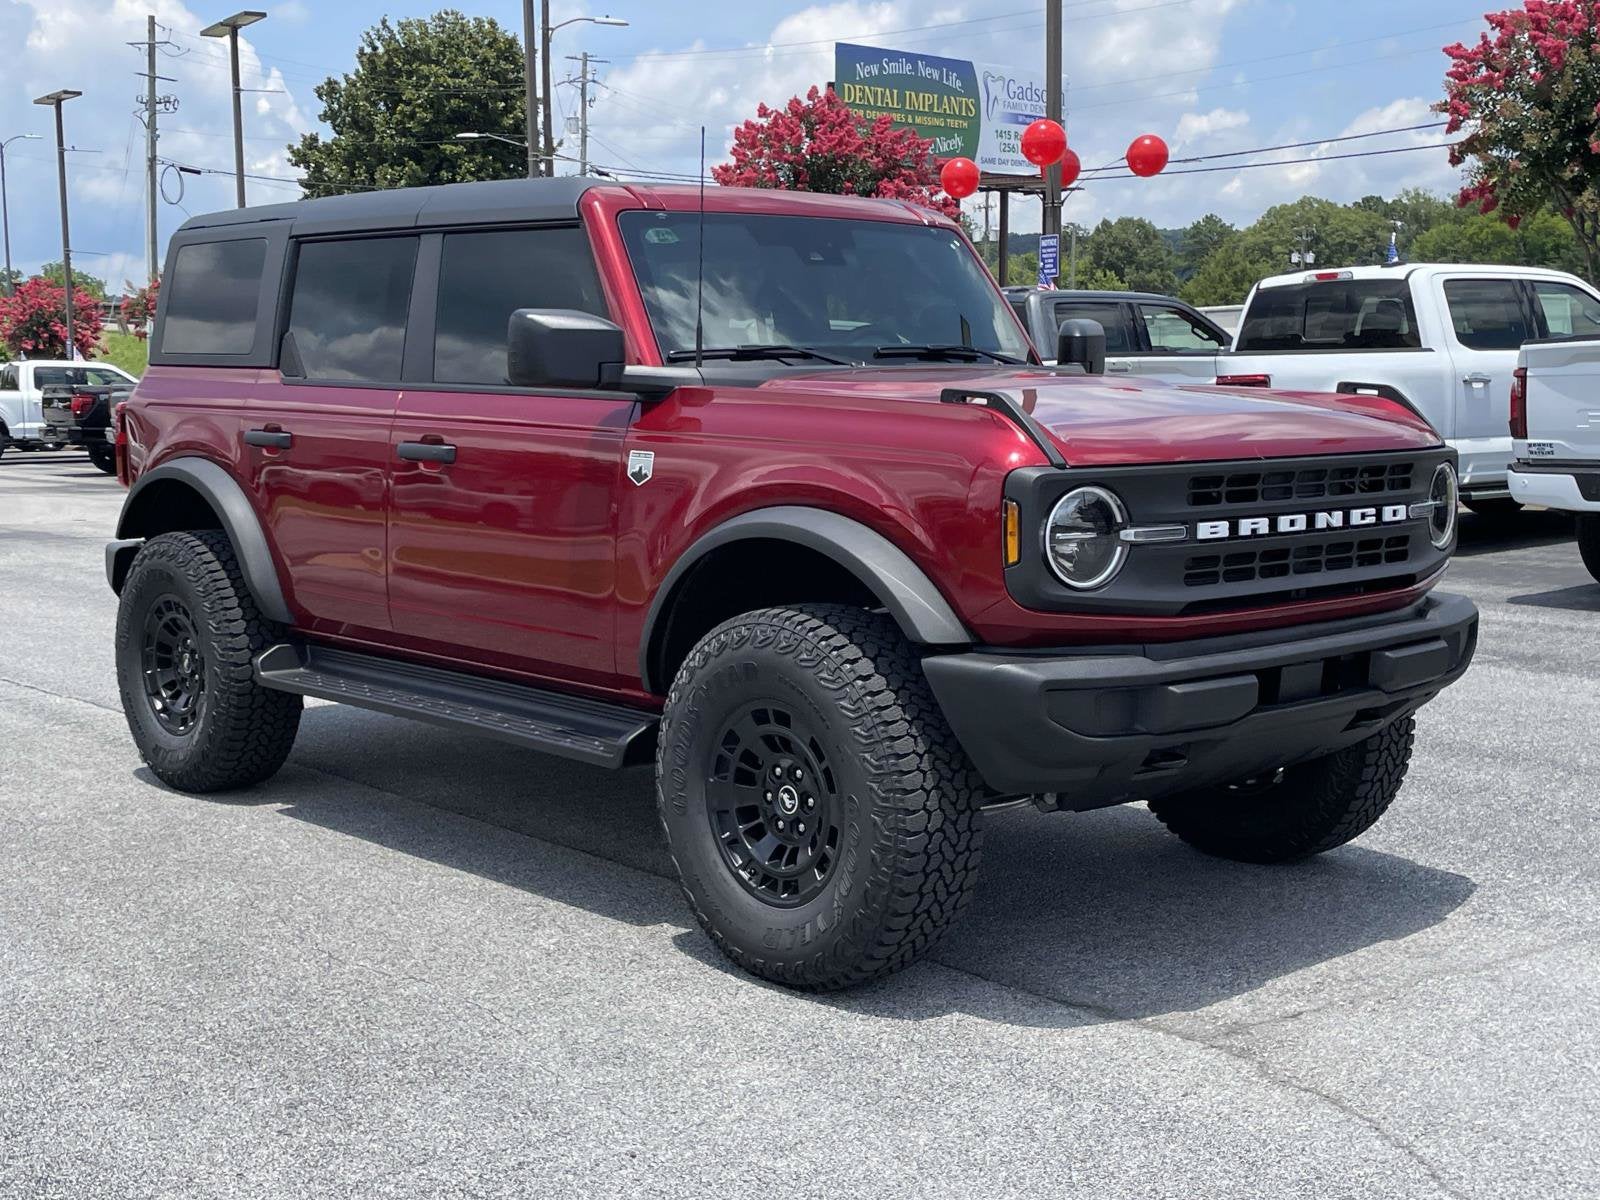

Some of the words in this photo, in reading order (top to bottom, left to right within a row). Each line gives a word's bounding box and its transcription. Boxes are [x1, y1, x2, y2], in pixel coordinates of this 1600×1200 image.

[856, 62, 879, 80] New
[882, 58, 915, 75] Smile.
[918, 60, 940, 81] New
[943, 68, 964, 93] Life.
[843, 83, 901, 109] DENTAL
[905, 91, 976, 117] IMPLANTS
[1003, 100, 1028, 112] FAMILY
[908, 114, 913, 123] &
[915, 116, 944, 127] MISSING
[947, 119, 968, 129] TEETH
[995, 129, 1011, 140] 1415
[935, 133, 964, 154] Nicely.
[1000, 143, 1019, 154] (256)
[980, 156, 996, 165] SAME
[998, 158, 1009, 166] DAY
[1196, 504, 1407, 540] BRONCO
